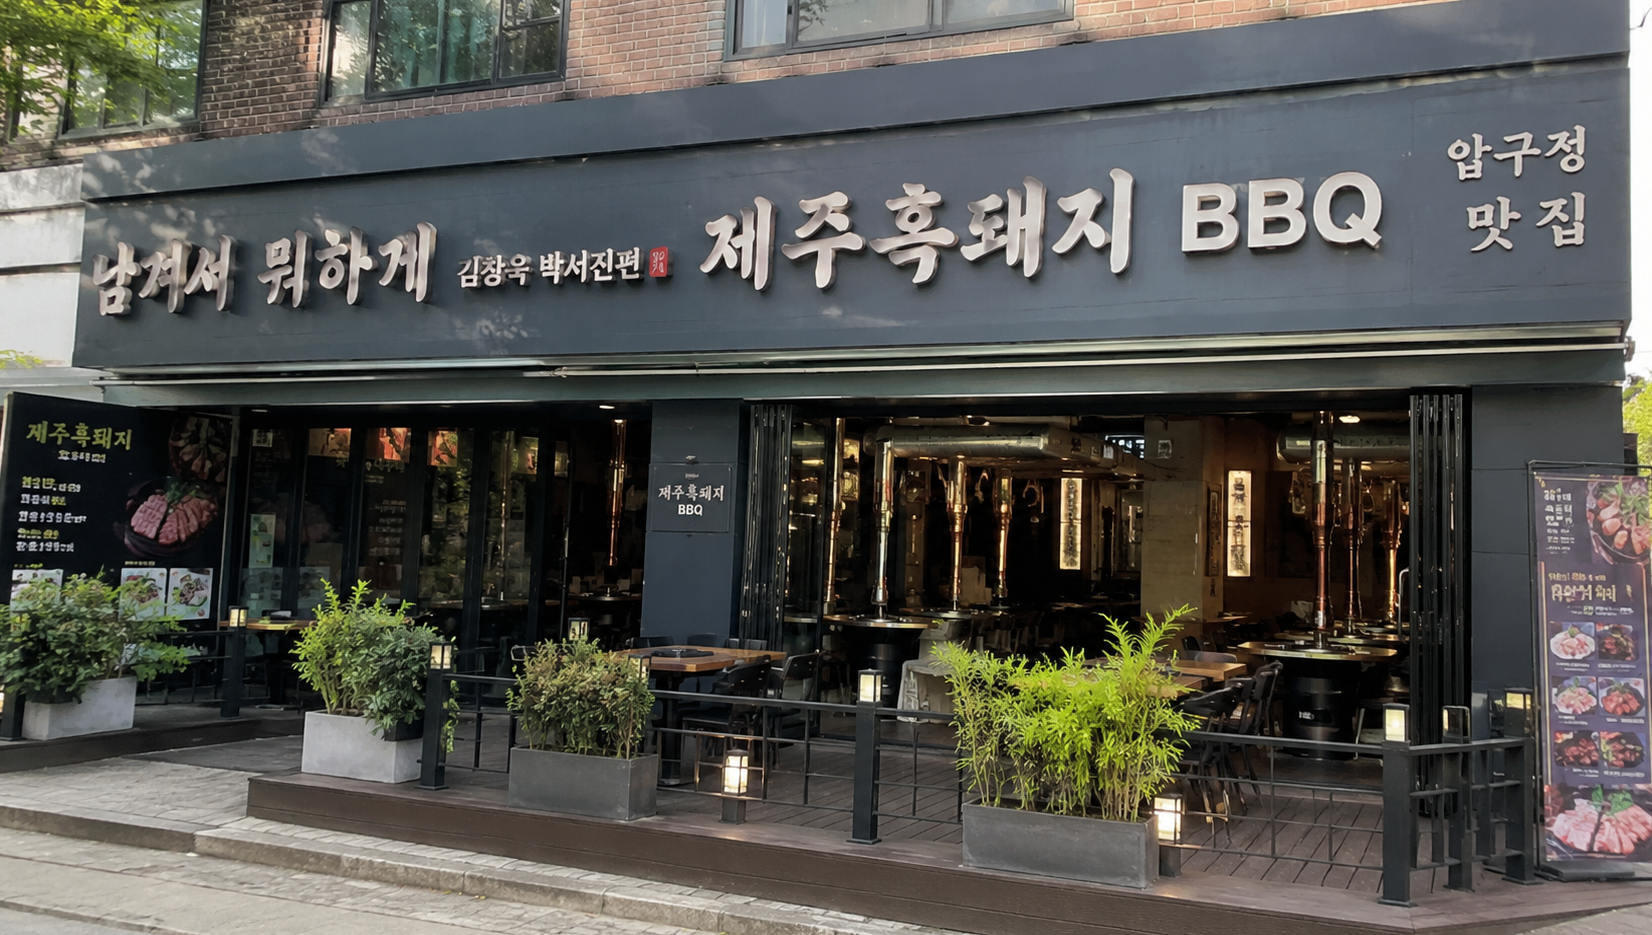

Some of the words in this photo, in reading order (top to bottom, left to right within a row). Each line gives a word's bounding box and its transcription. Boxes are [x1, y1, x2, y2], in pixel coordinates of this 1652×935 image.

[1447, 124, 1587, 181] 압구정
[699, 167, 1136, 291] 제주흑돼지
[1181, 171, 1383, 253] BBQ
[92, 233, 235, 316] 남겨서
[257, 221, 438, 308] 뭐하게
[457, 253, 532, 289] 김창욱
[539, 246, 642, 284] 박서진편
[26, 420, 132, 450] 제주흑돼지
[678, 504, 703, 516] BBQ
